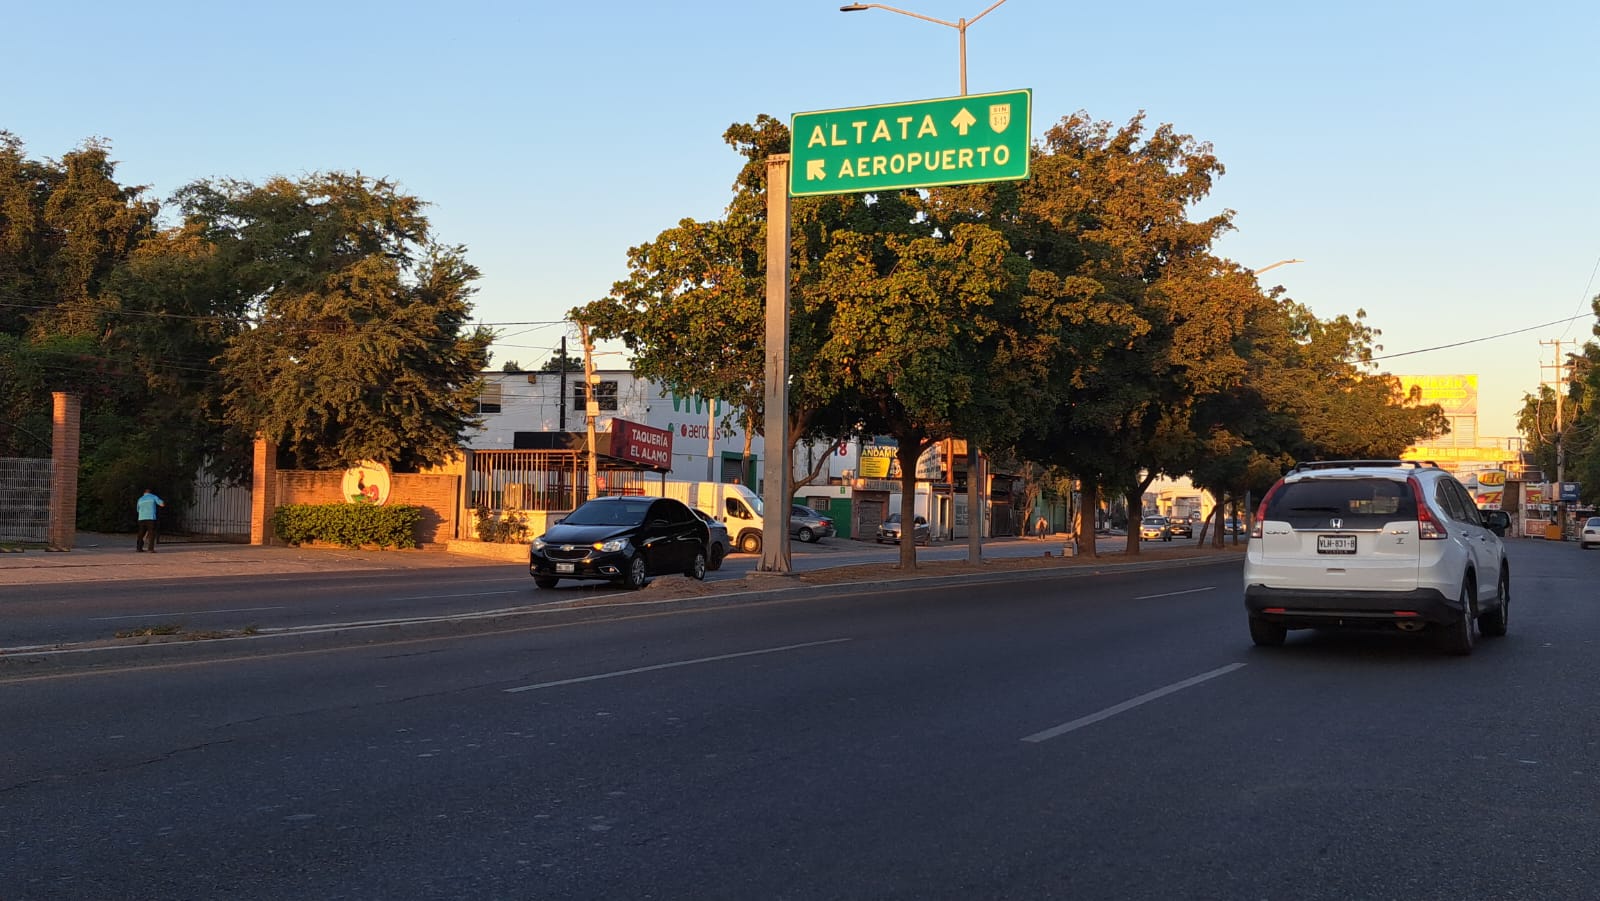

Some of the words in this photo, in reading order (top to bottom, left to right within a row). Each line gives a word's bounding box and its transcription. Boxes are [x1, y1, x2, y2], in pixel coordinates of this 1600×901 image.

[807, 114, 938, 148] ALTATA
[838, 145, 1010, 178] AEROPUERTO
[632, 429, 668, 447] TAQUERÍA
[630, 445, 640, 457] EL
[641, 448, 667, 461] ALAMO
